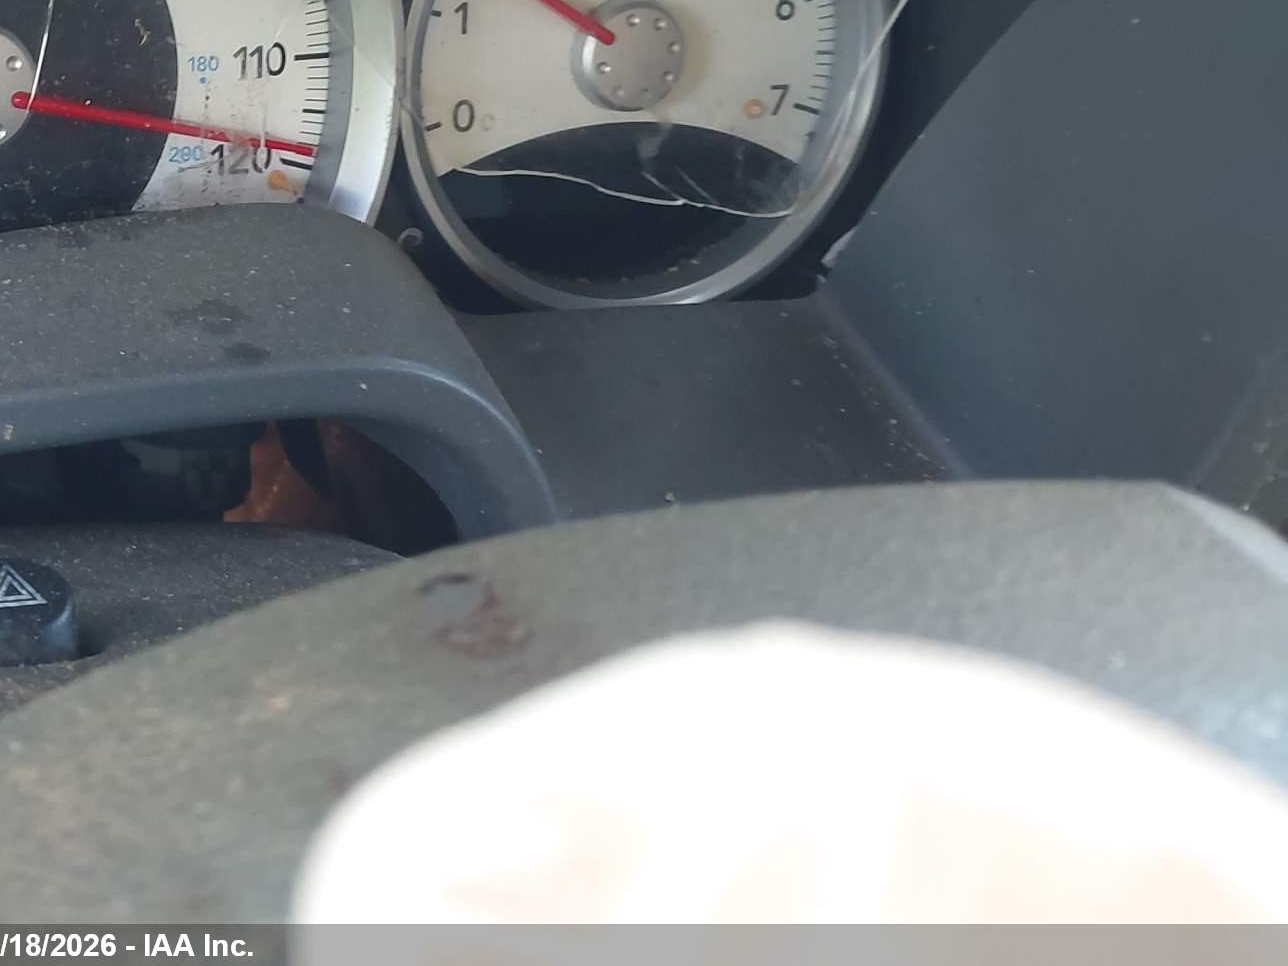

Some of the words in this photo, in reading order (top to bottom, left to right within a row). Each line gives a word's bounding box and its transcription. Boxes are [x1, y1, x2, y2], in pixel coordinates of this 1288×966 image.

[454, 2, 469, 35] 1
[187, 54, 220, 73] 180
[232, 44, 287, 79] 110
[452, 100, 476, 133] 0
[769, 84, 791, 117] 7
[210, 142, 272, 176] 120
